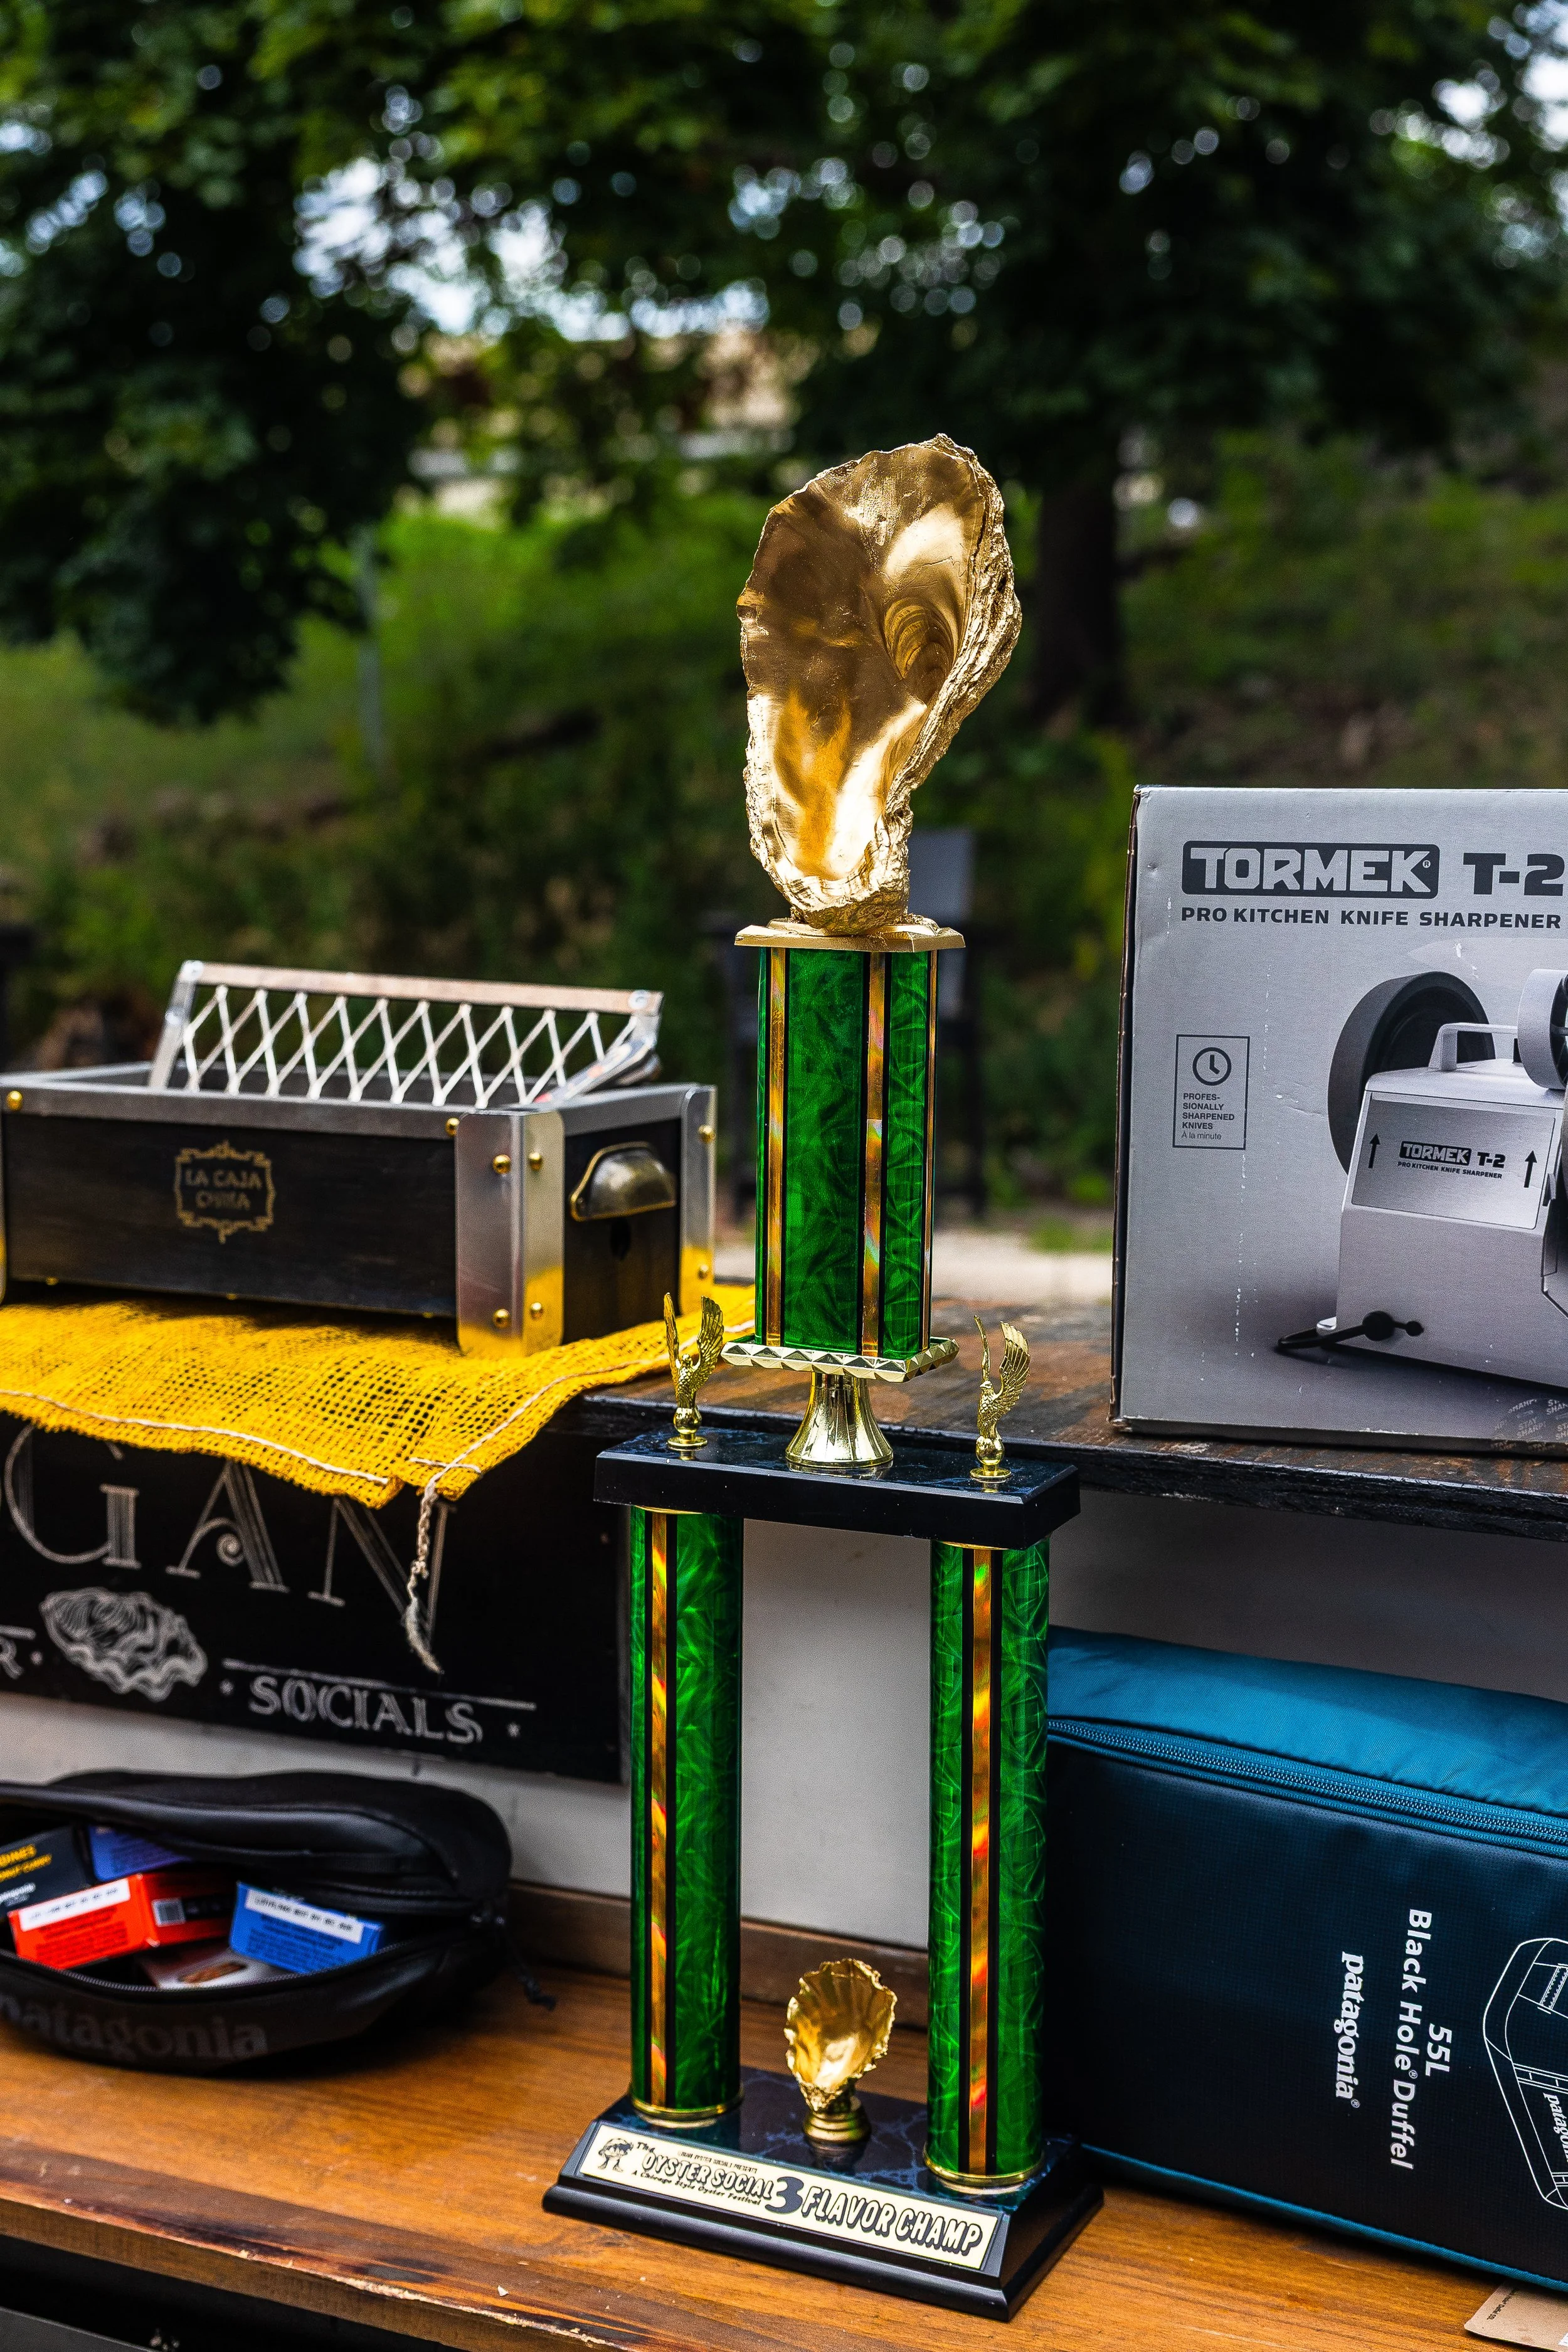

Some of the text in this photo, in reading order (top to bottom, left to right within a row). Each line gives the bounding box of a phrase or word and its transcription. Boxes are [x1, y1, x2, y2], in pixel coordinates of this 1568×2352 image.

[1463, 853, 1565, 896] T-2
[1182, 907, 1561, 929] PRO KITCHEN KNIFE SHARPENER
[1182, 1102, 1224, 1111] SIONALLY
[1183, 1093, 1221, 1101] PROFES-
[1182, 1112, 1235, 1121] SHARPENED
[1182, 1121, 1213, 1130] KNIVES
[1411, 1163, 1439, 1172] KITCHEN
[1441, 1166, 1460, 1174] KNIFE
[1462, 1169, 1503, 1179] SHARPENER
[1477, 1152, 1506, 1169] T-2
[184, 1168, 263, 1190] LA CAJA
[0, 1422, 458, 1652] GAN
[248, 1675, 484, 1745] SOCIALS
[1401, 1909, 1433, 1993] Black
[1424, 2023, 1453, 2077] 55L
[1390, 2079, 1417, 2170] Duffel
[642, 2151, 983, 2256] OYSTER SOCIAL 3 FLAVOR CHAMP
[674, 2179, 696, 2190] Style
[698, 2185, 726, 2198] Oyster
[727, 2192, 761, 2206] Festival
